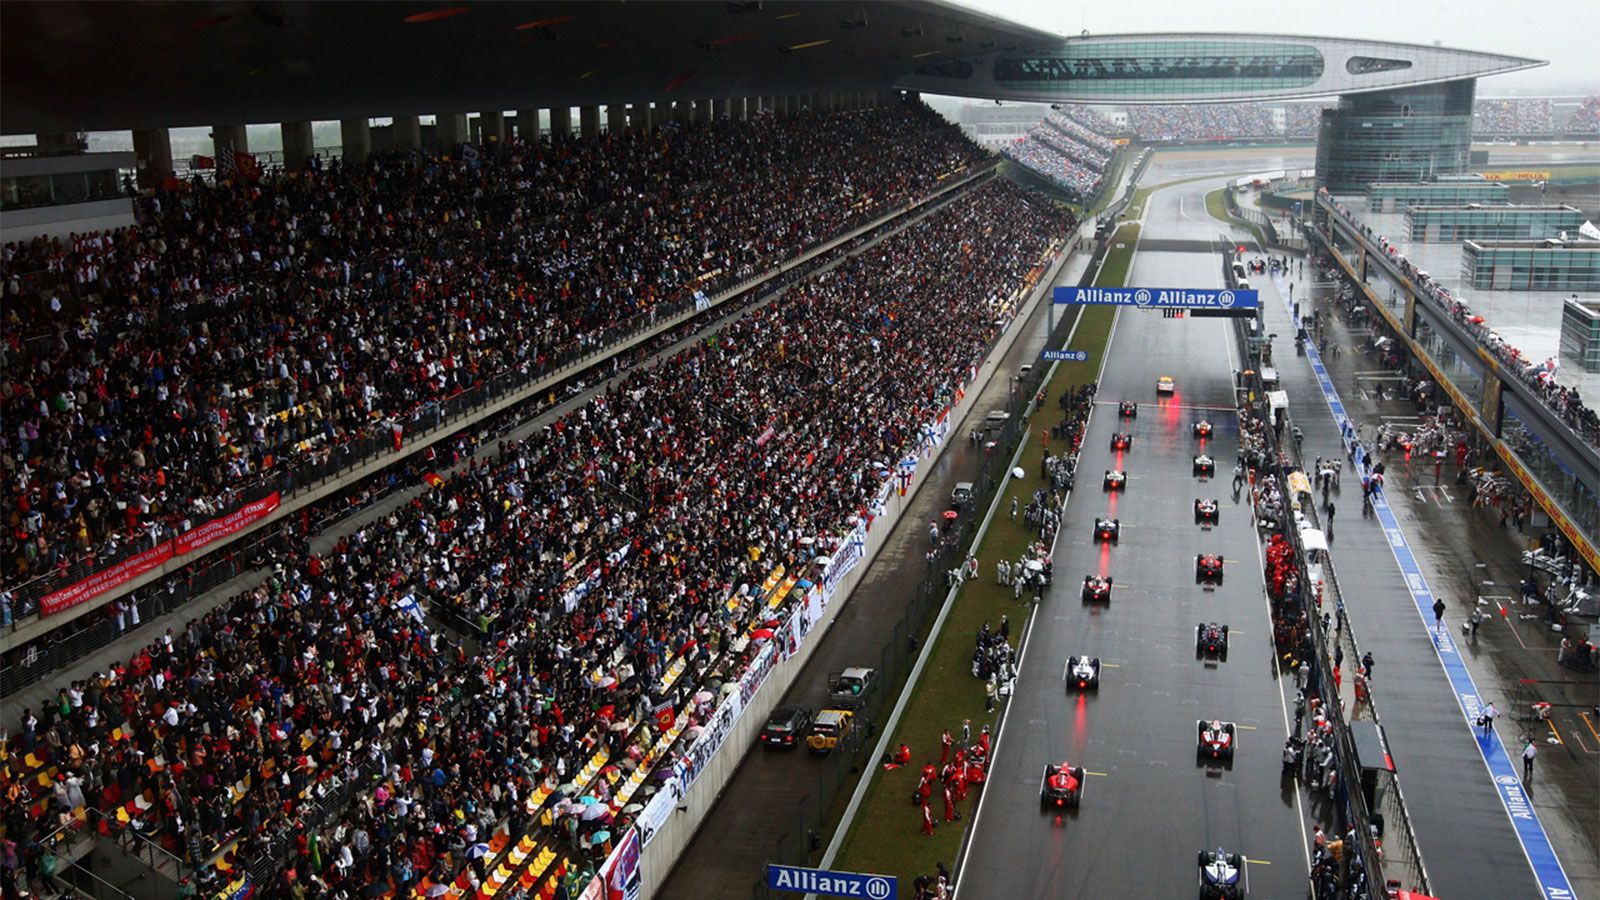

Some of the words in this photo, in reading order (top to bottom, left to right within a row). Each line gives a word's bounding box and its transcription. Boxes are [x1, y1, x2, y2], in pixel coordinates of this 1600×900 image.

[1075, 289, 1132, 304] Allianz
[1158, 291, 1215, 305] Allianz
[1044, 351, 1076, 360] Allianz
[1505, 785, 1534, 820] Allianz
[776, 868, 861, 896] Allianz
